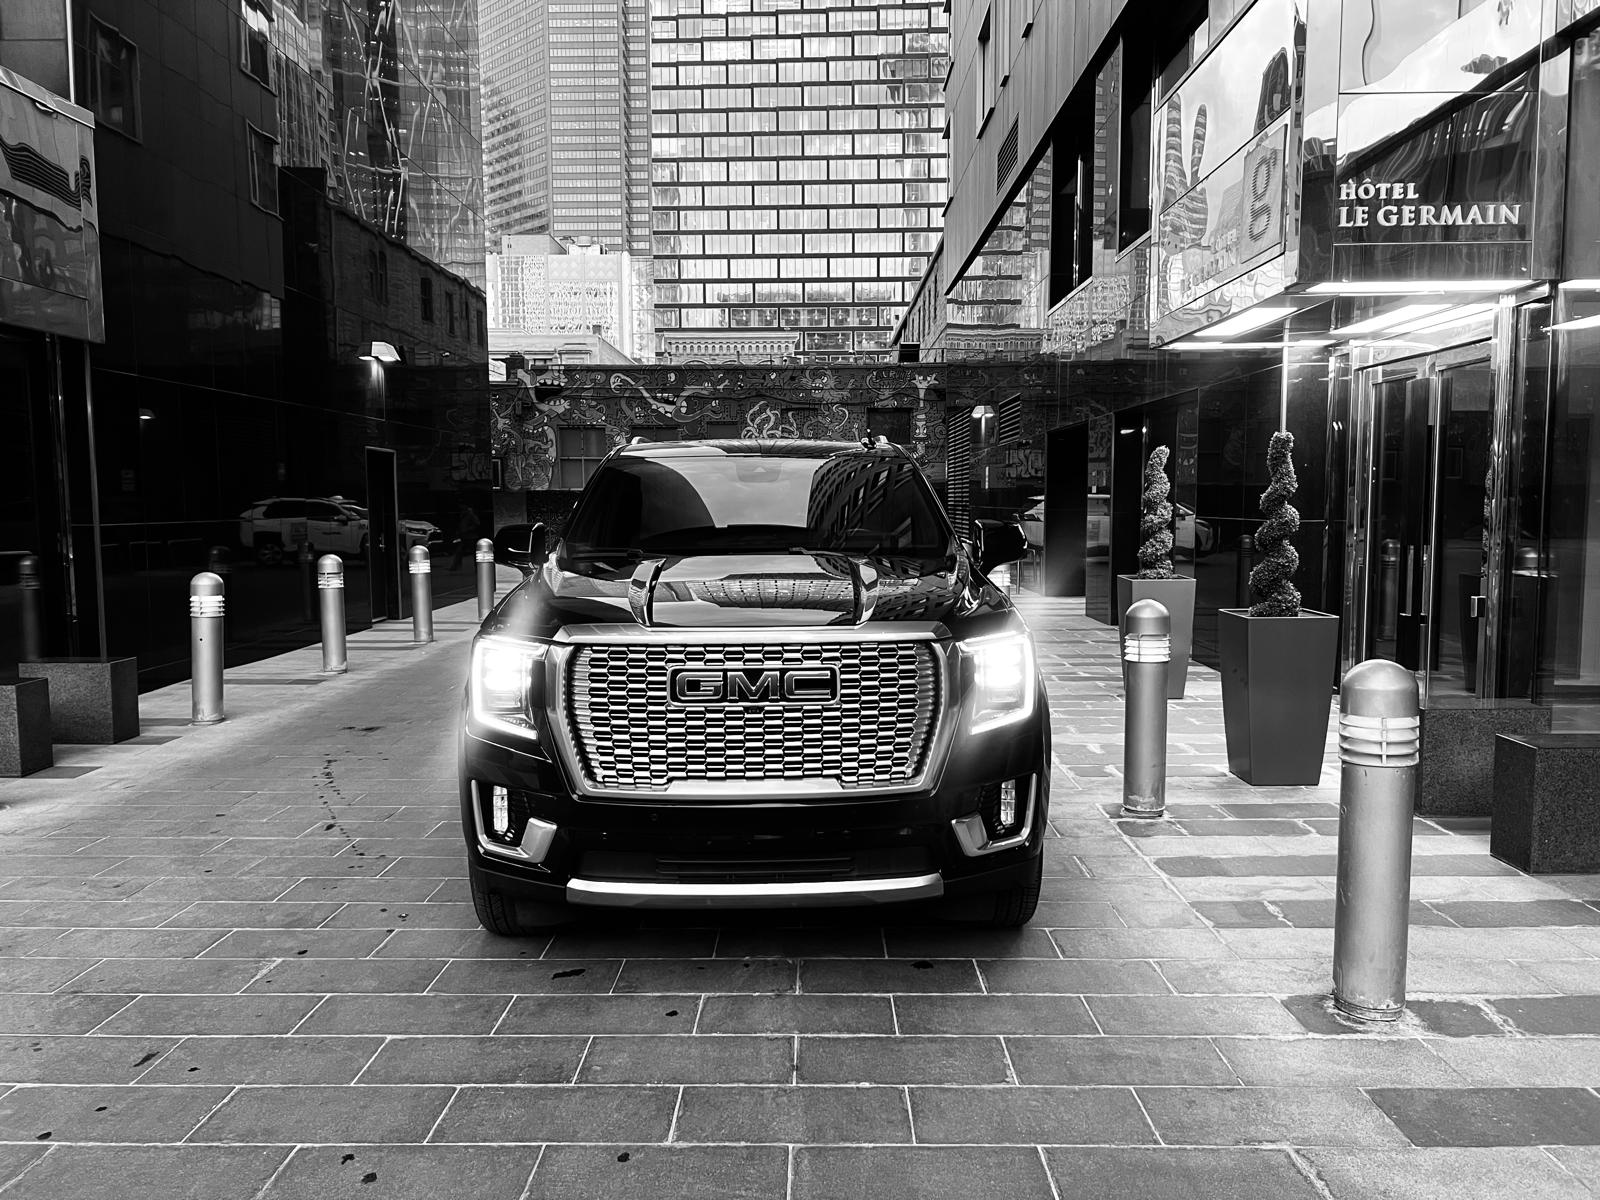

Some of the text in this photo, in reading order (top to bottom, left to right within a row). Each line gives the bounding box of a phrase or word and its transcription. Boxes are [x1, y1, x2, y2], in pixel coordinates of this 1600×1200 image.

[1338, 178, 1419, 200] HÔTEL
[1338, 204, 1521, 227] LE GERMAIN
[676, 670, 832, 700] GMC
